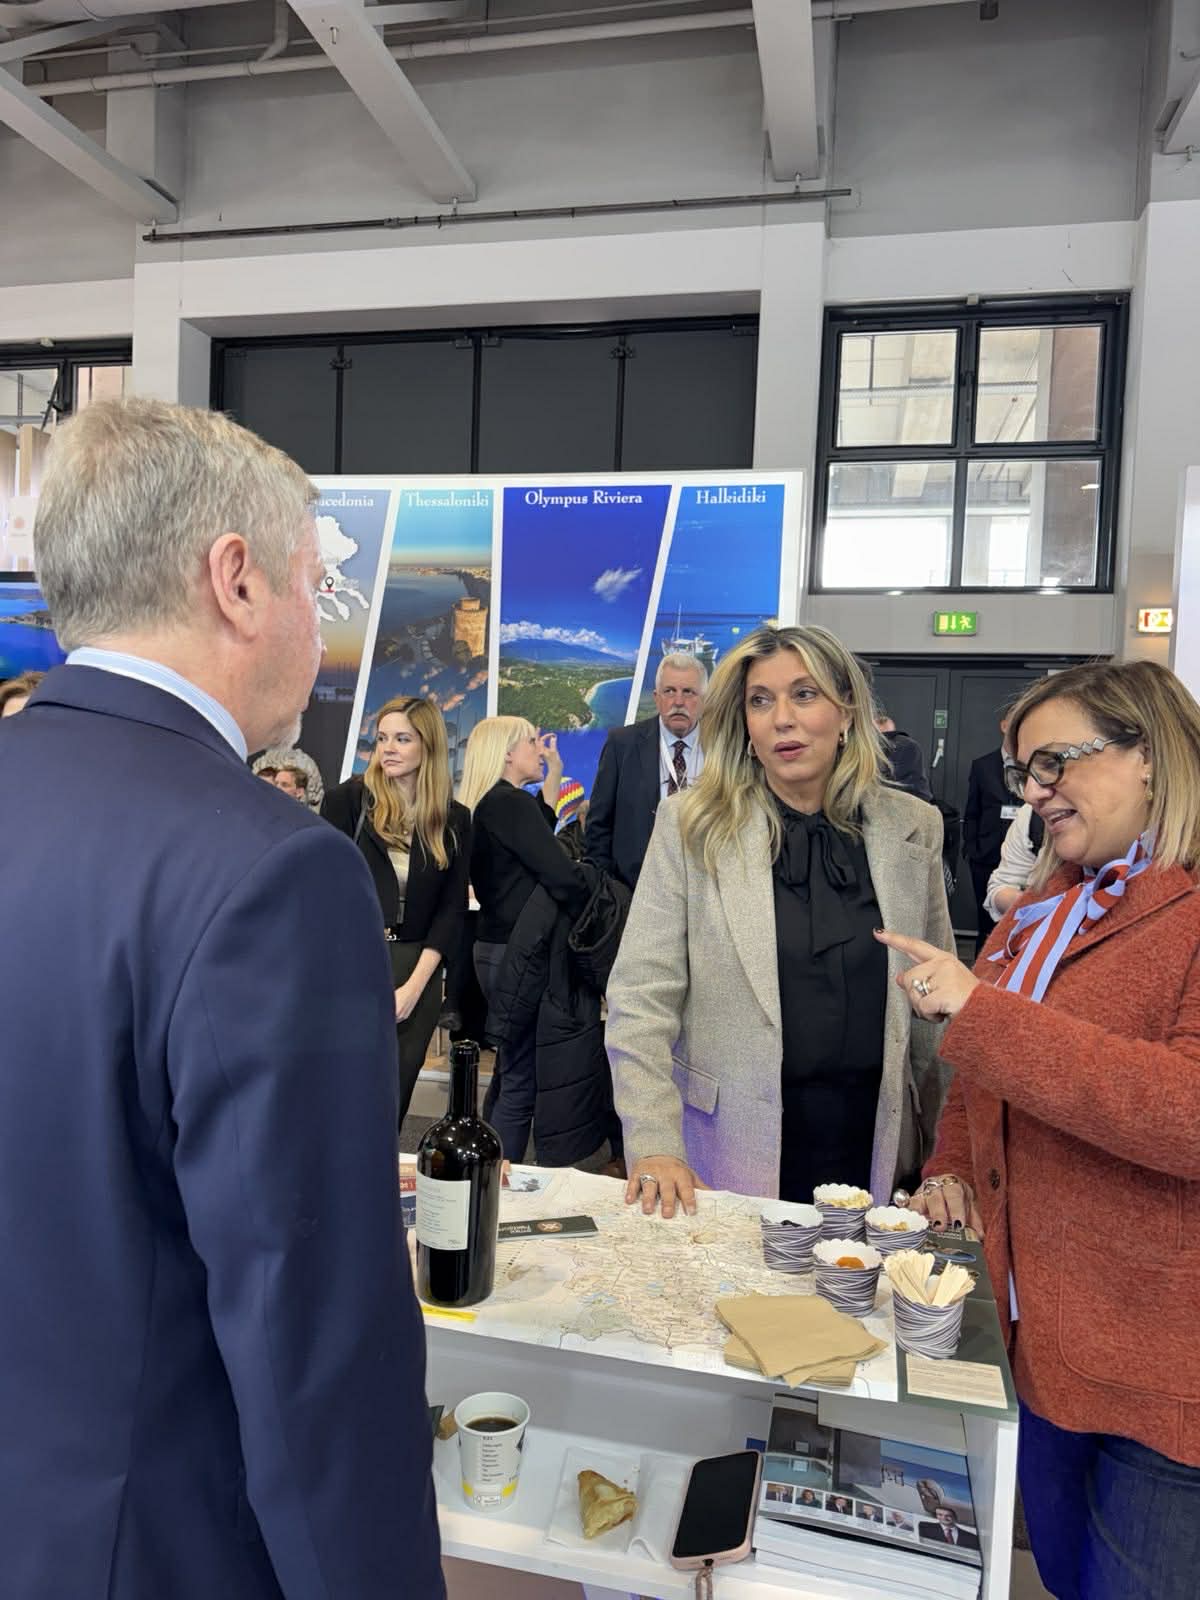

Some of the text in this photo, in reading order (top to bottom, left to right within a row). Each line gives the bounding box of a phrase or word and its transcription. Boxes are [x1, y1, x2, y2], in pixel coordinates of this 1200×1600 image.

[314, 491, 374, 507] acedonia
[406, 489, 489, 507] Thessaloniki
[524, 489, 643, 508] Olympus Riviera
[695, 487, 767, 505] Halkidiki
